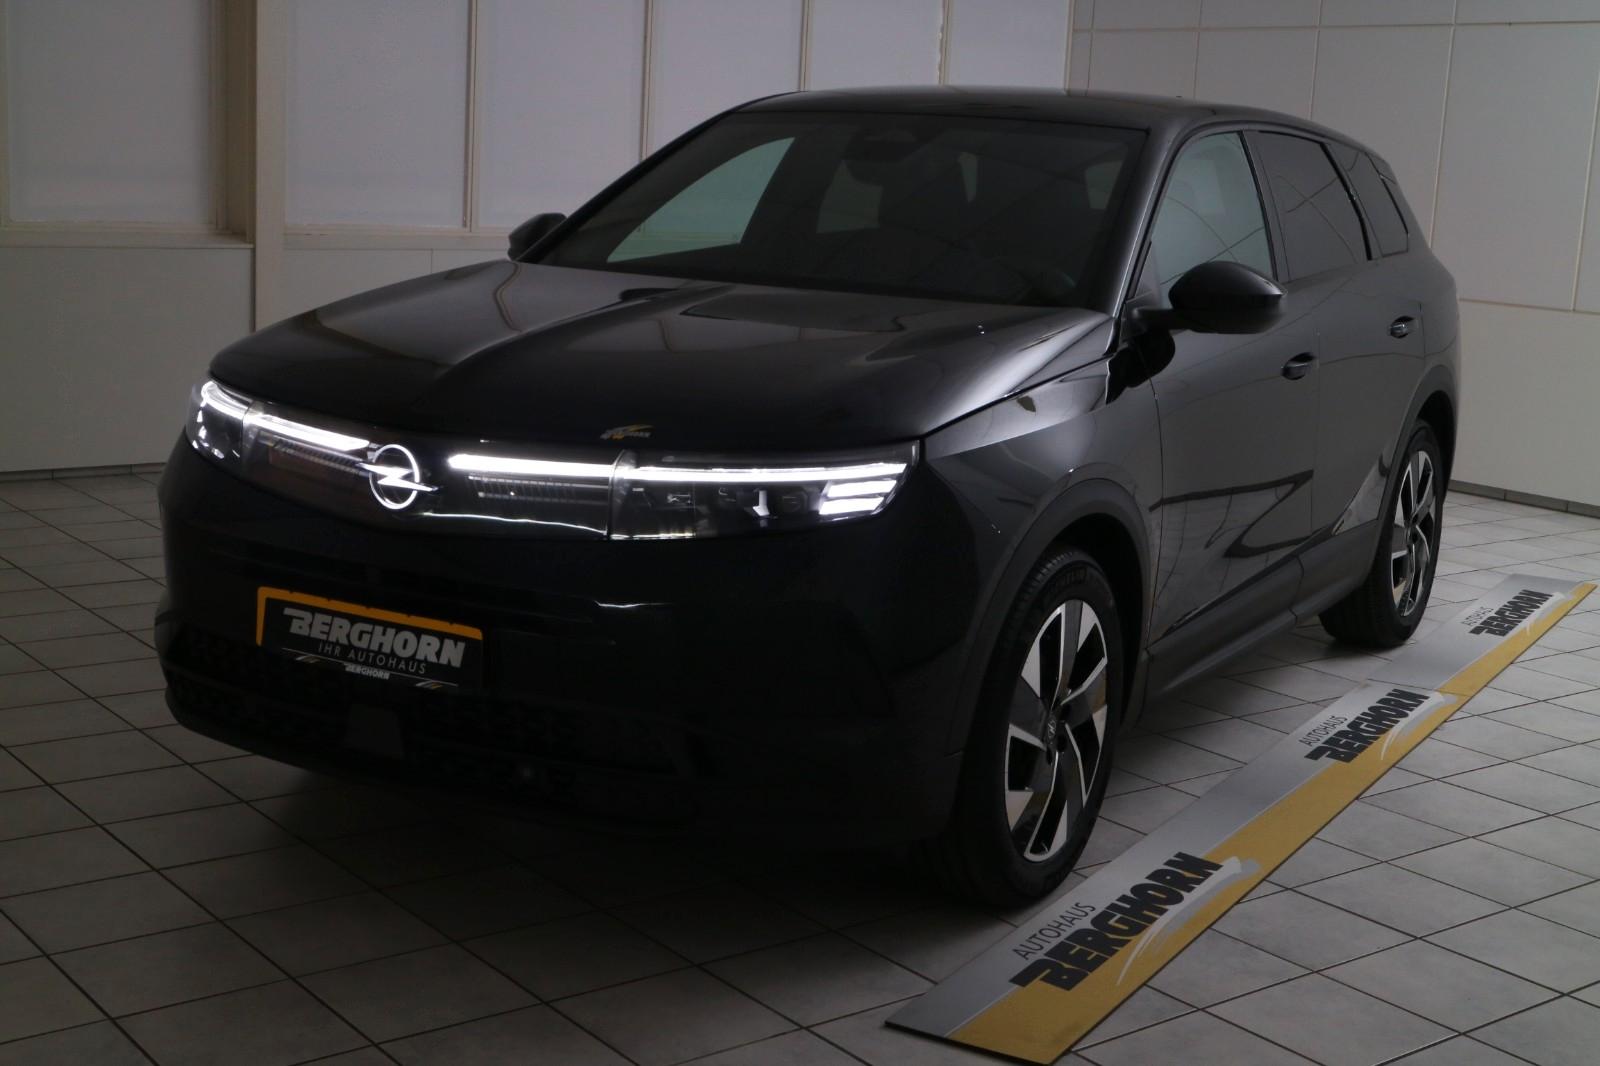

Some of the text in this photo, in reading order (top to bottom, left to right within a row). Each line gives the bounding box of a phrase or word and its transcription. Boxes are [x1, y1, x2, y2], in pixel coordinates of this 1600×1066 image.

[283, 607, 466, 668] BERGHORN
[1468, 588, 1554, 637] BERGHORN
[319, 641, 427, 674] IHR AUTOHAUS
[1304, 688, 1430, 763] BERGHORN
[1008, 851, 1224, 991] BERGHORN
[1012, 901, 1097, 960] AUTOHAUS
